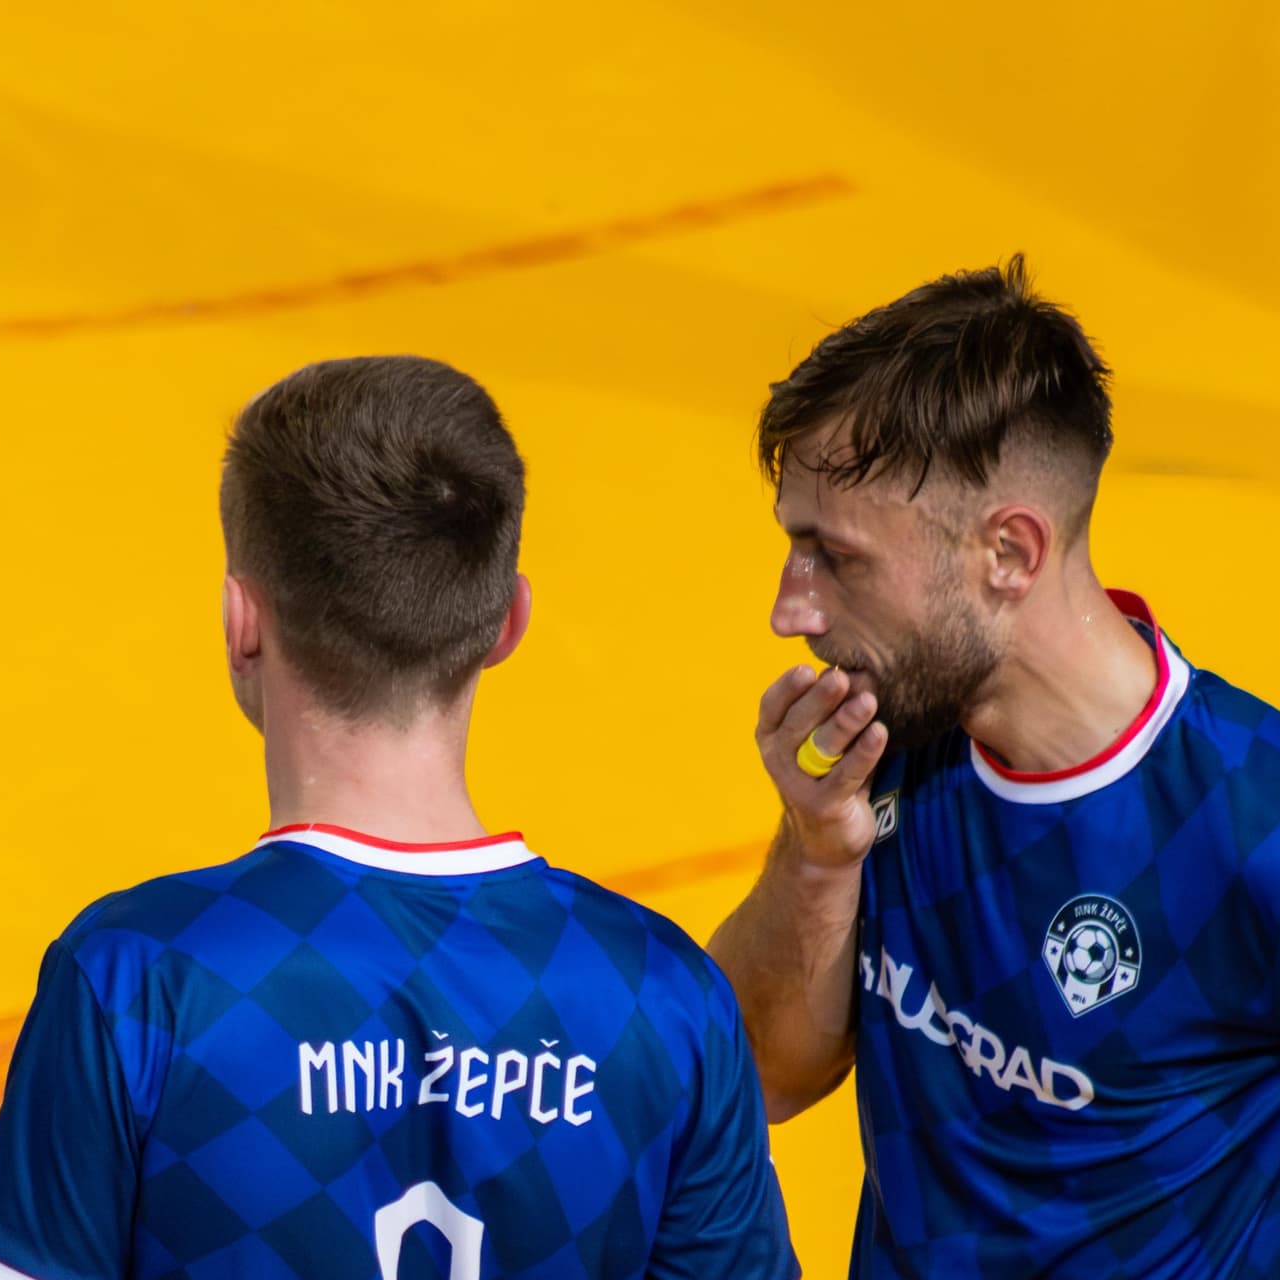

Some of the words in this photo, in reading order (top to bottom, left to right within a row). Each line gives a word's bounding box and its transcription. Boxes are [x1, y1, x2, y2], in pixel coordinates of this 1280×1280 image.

[1074, 903, 1098, 918] MNK
[298, 1038, 404, 1115] MNK
[418, 1030, 597, 1127] ŽEPČE
